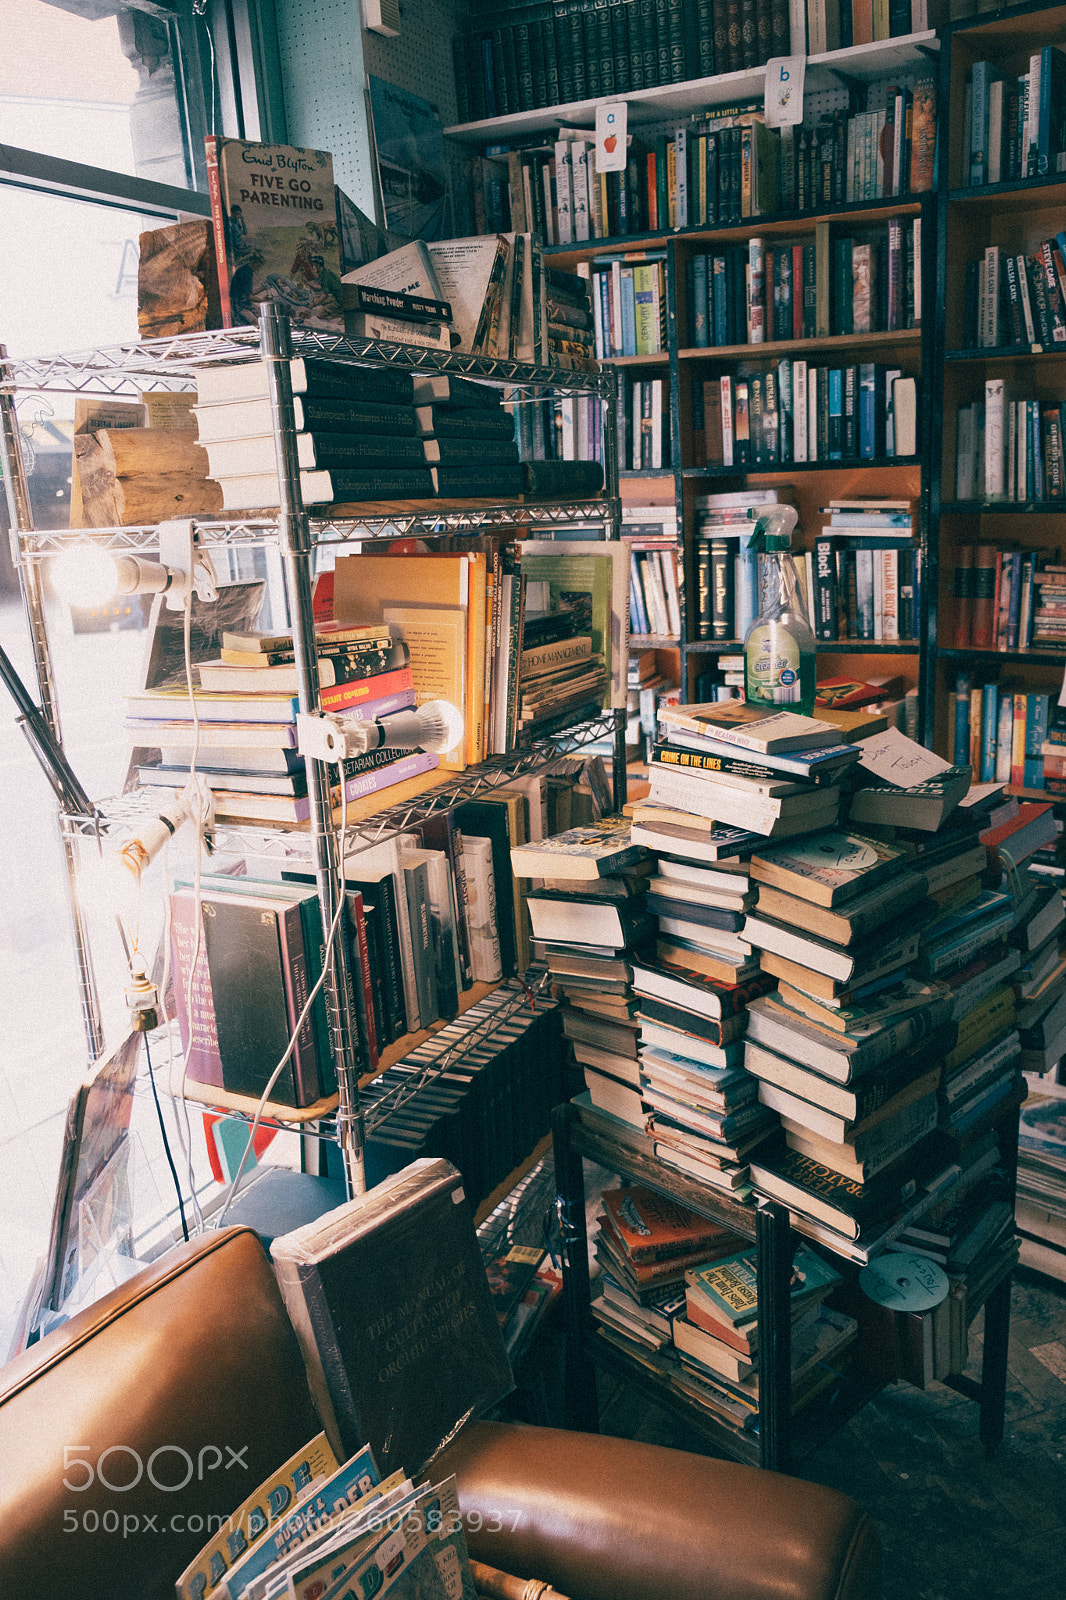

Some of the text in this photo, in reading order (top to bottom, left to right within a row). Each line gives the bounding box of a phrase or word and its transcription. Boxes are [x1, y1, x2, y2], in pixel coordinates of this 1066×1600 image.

[780, 65, 790, 82] b
[606, 112, 616, 125] a
[705, 111, 718, 120] DIE
[724, 107, 739, 118] LITTLE
[241, 149, 316, 173] Enid Blyton
[250, 173, 312, 193] FIVE GO
[239, 189, 324, 212] PARENTING
[216, 220, 222, 230] GO
[217, 230, 225, 264] PARENTING
[1042, 244, 1054, 268] STEVE
[1006, 258, 1016, 284] CHELSEA
[1009, 284, 1018, 301] CAIN
[640, 303, 650, 342] CENTURY
[846, 368, 854, 416] DAMAGED GOODS
[1050, 424, 1058, 462] GENESIS
[816, 542, 832, 578] Block
[716, 563, 726, 614] Lorna Doone
[884, 554, 896, 616] WILLIAM BOYD
[527, 642, 587, 668] HOME MANAGEMENT
[754, 658, 788, 672] Cleaer
[333, 755, 375, 779] VGETARIAN
[660, 750, 680, 765] CRIME
[680, 753, 690, 766] ON
[690, 754, 702, 768] THE
[702, 756, 722, 771] LINES
[420, 903, 429, 951] BLUMENTHAL
[486, 873, 501, 962] COOKERY YEAR
[362, 946, 372, 989] Cooking
[780, 1163, 836, 1197] TERRY
[637, 1242, 660, 1255] ALIEN
[660, 1238, 694, 1251] EMBASSY
[706, 1272, 747, 1311] Tales From The
[717, 1268, 740, 1289] Behind
[366, 1260, 466, 1341] THE MANUAL OF
[386, 1289, 461, 1352] CULTIVATED
[378, 1300, 478, 1384] ORCHID SPECIES
[187, 1461, 314, 1599] PARADE
[274, 1497, 326, 1548] MUSCLE &
